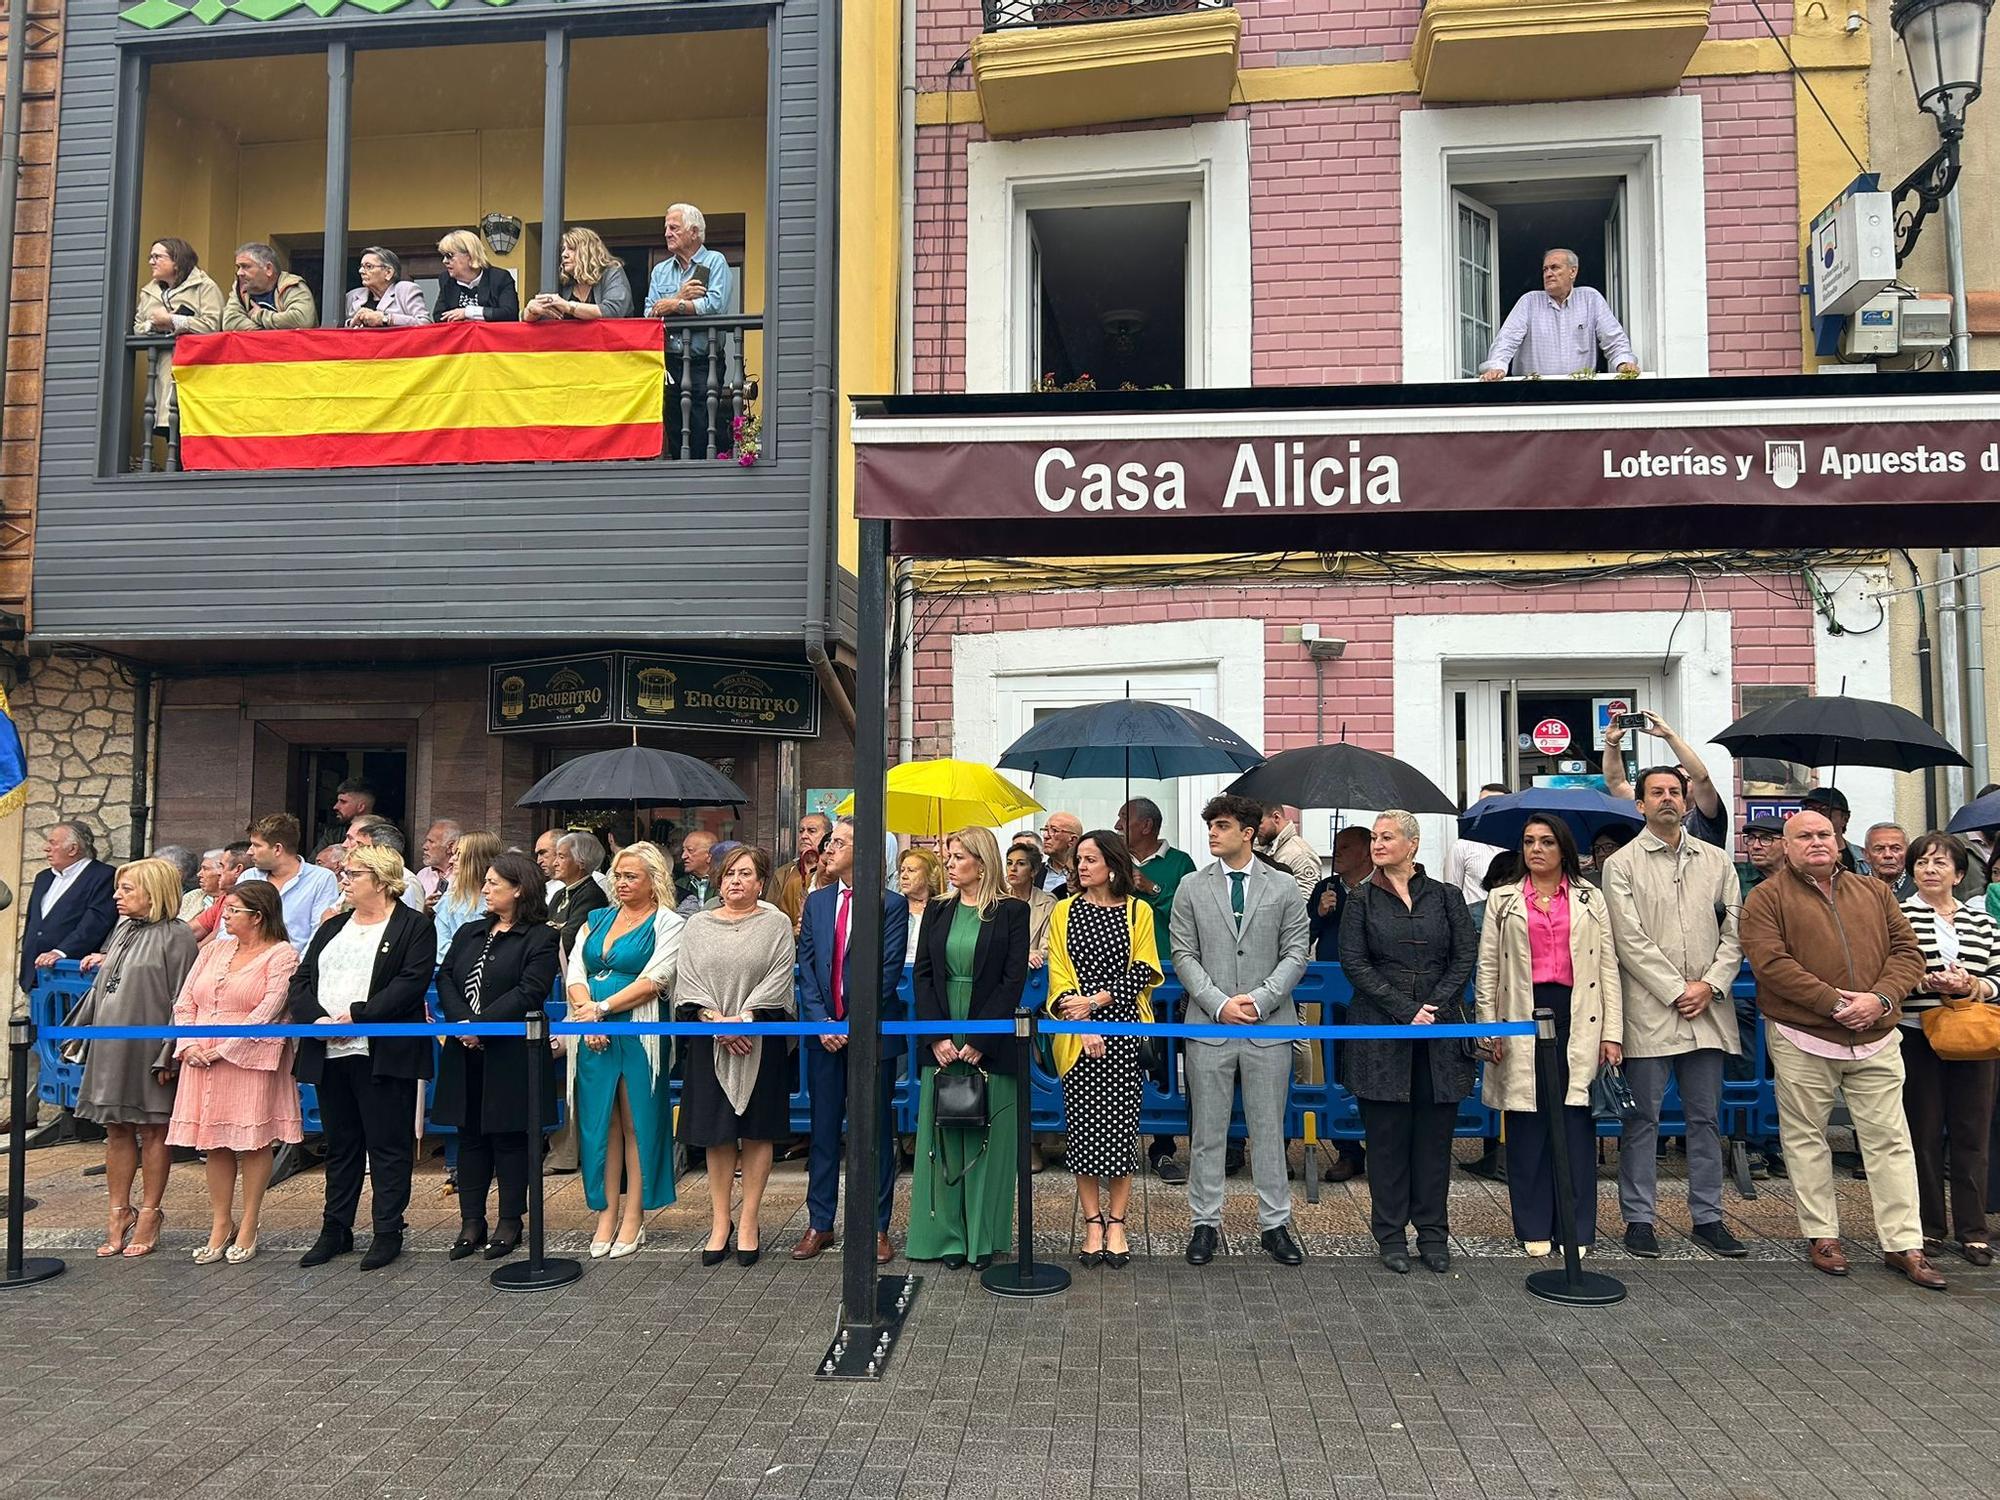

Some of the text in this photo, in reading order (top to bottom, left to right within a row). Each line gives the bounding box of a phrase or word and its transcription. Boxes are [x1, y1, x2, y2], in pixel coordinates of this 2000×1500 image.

[1033, 440, 1402, 513] Casa Alicia
[1603, 447, 1727, 479] Loterías
[1735, 454, 1753, 481] y
[1819, 445, 1967, 480] Apuestas
[1540, 723, 1562, 736] +18
